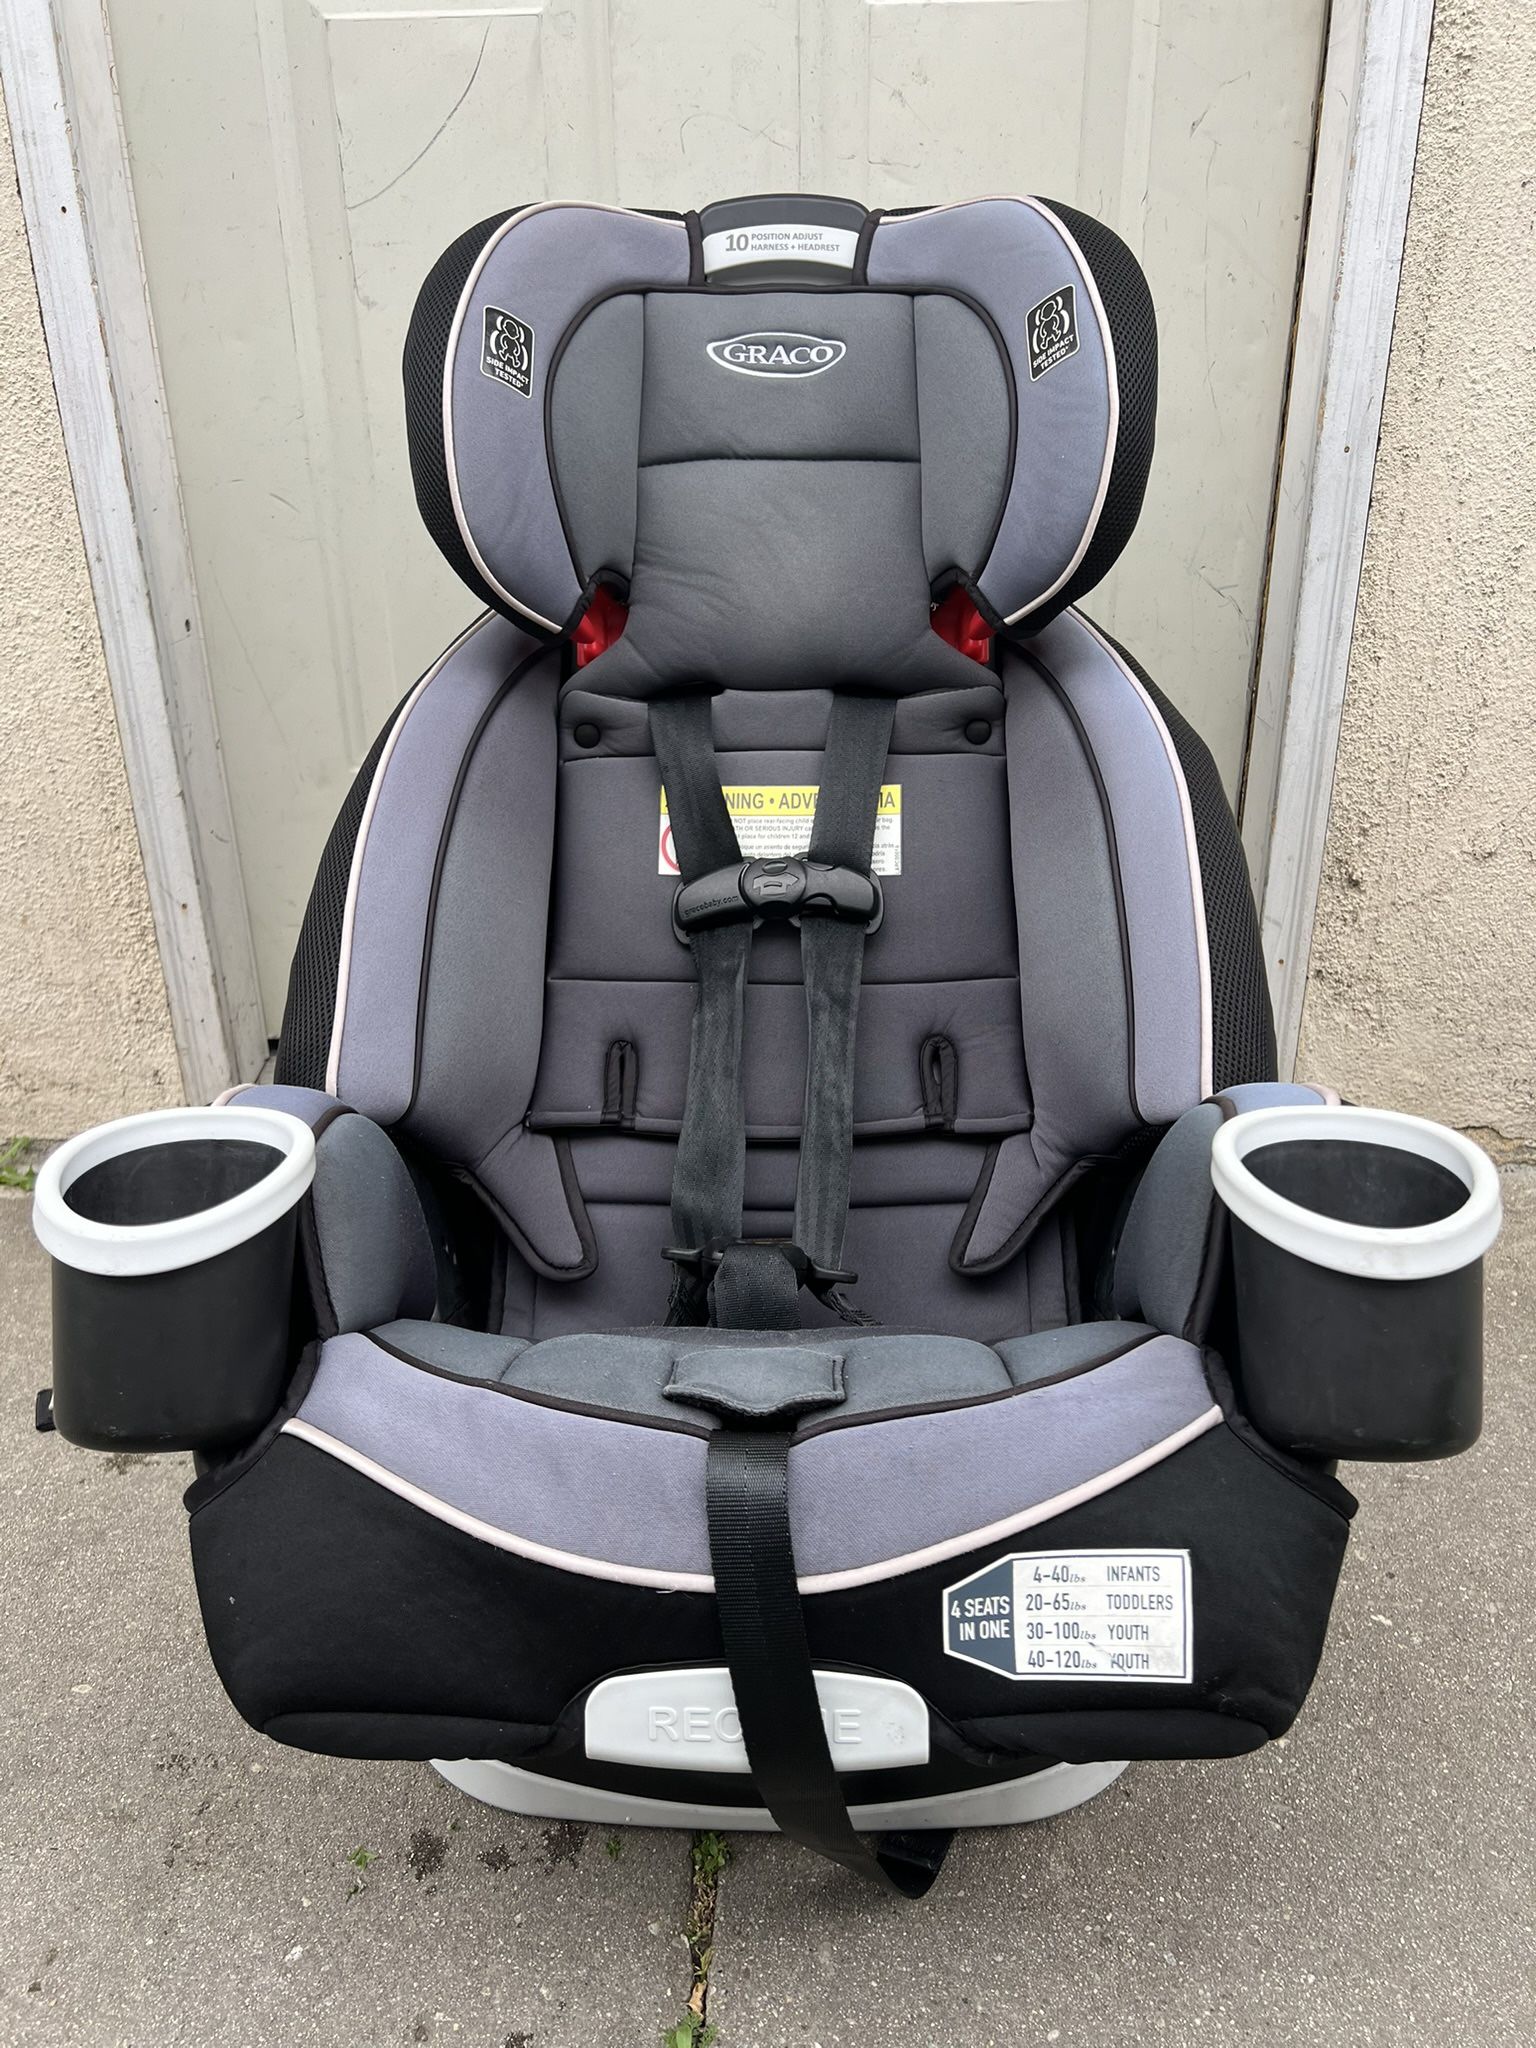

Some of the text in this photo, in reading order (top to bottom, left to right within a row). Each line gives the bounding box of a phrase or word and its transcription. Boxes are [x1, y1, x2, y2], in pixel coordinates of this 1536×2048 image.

[725, 233, 749, 251] 10
[751, 243, 789, 251] HARNESS
[797, 243, 840, 252] HEADREST
[723, 343, 834, 365] GRACO
[1032, 334, 1075, 369] SIDE IMPACT
[486, 356, 529, 385] SIDE IMPACT
[725, 792, 764, 809] NING
[1106, 1565, 1161, 1582] INFANTS
[951, 1595, 1011, 1618] 4 SEATS
[1106, 1594, 1174, 1611] TODDLERS
[959, 1619, 1011, 1641] IN ONE
[1107, 1624, 1150, 1641] YOUTH
[1110, 1652, 1150, 1670] YOUTH
